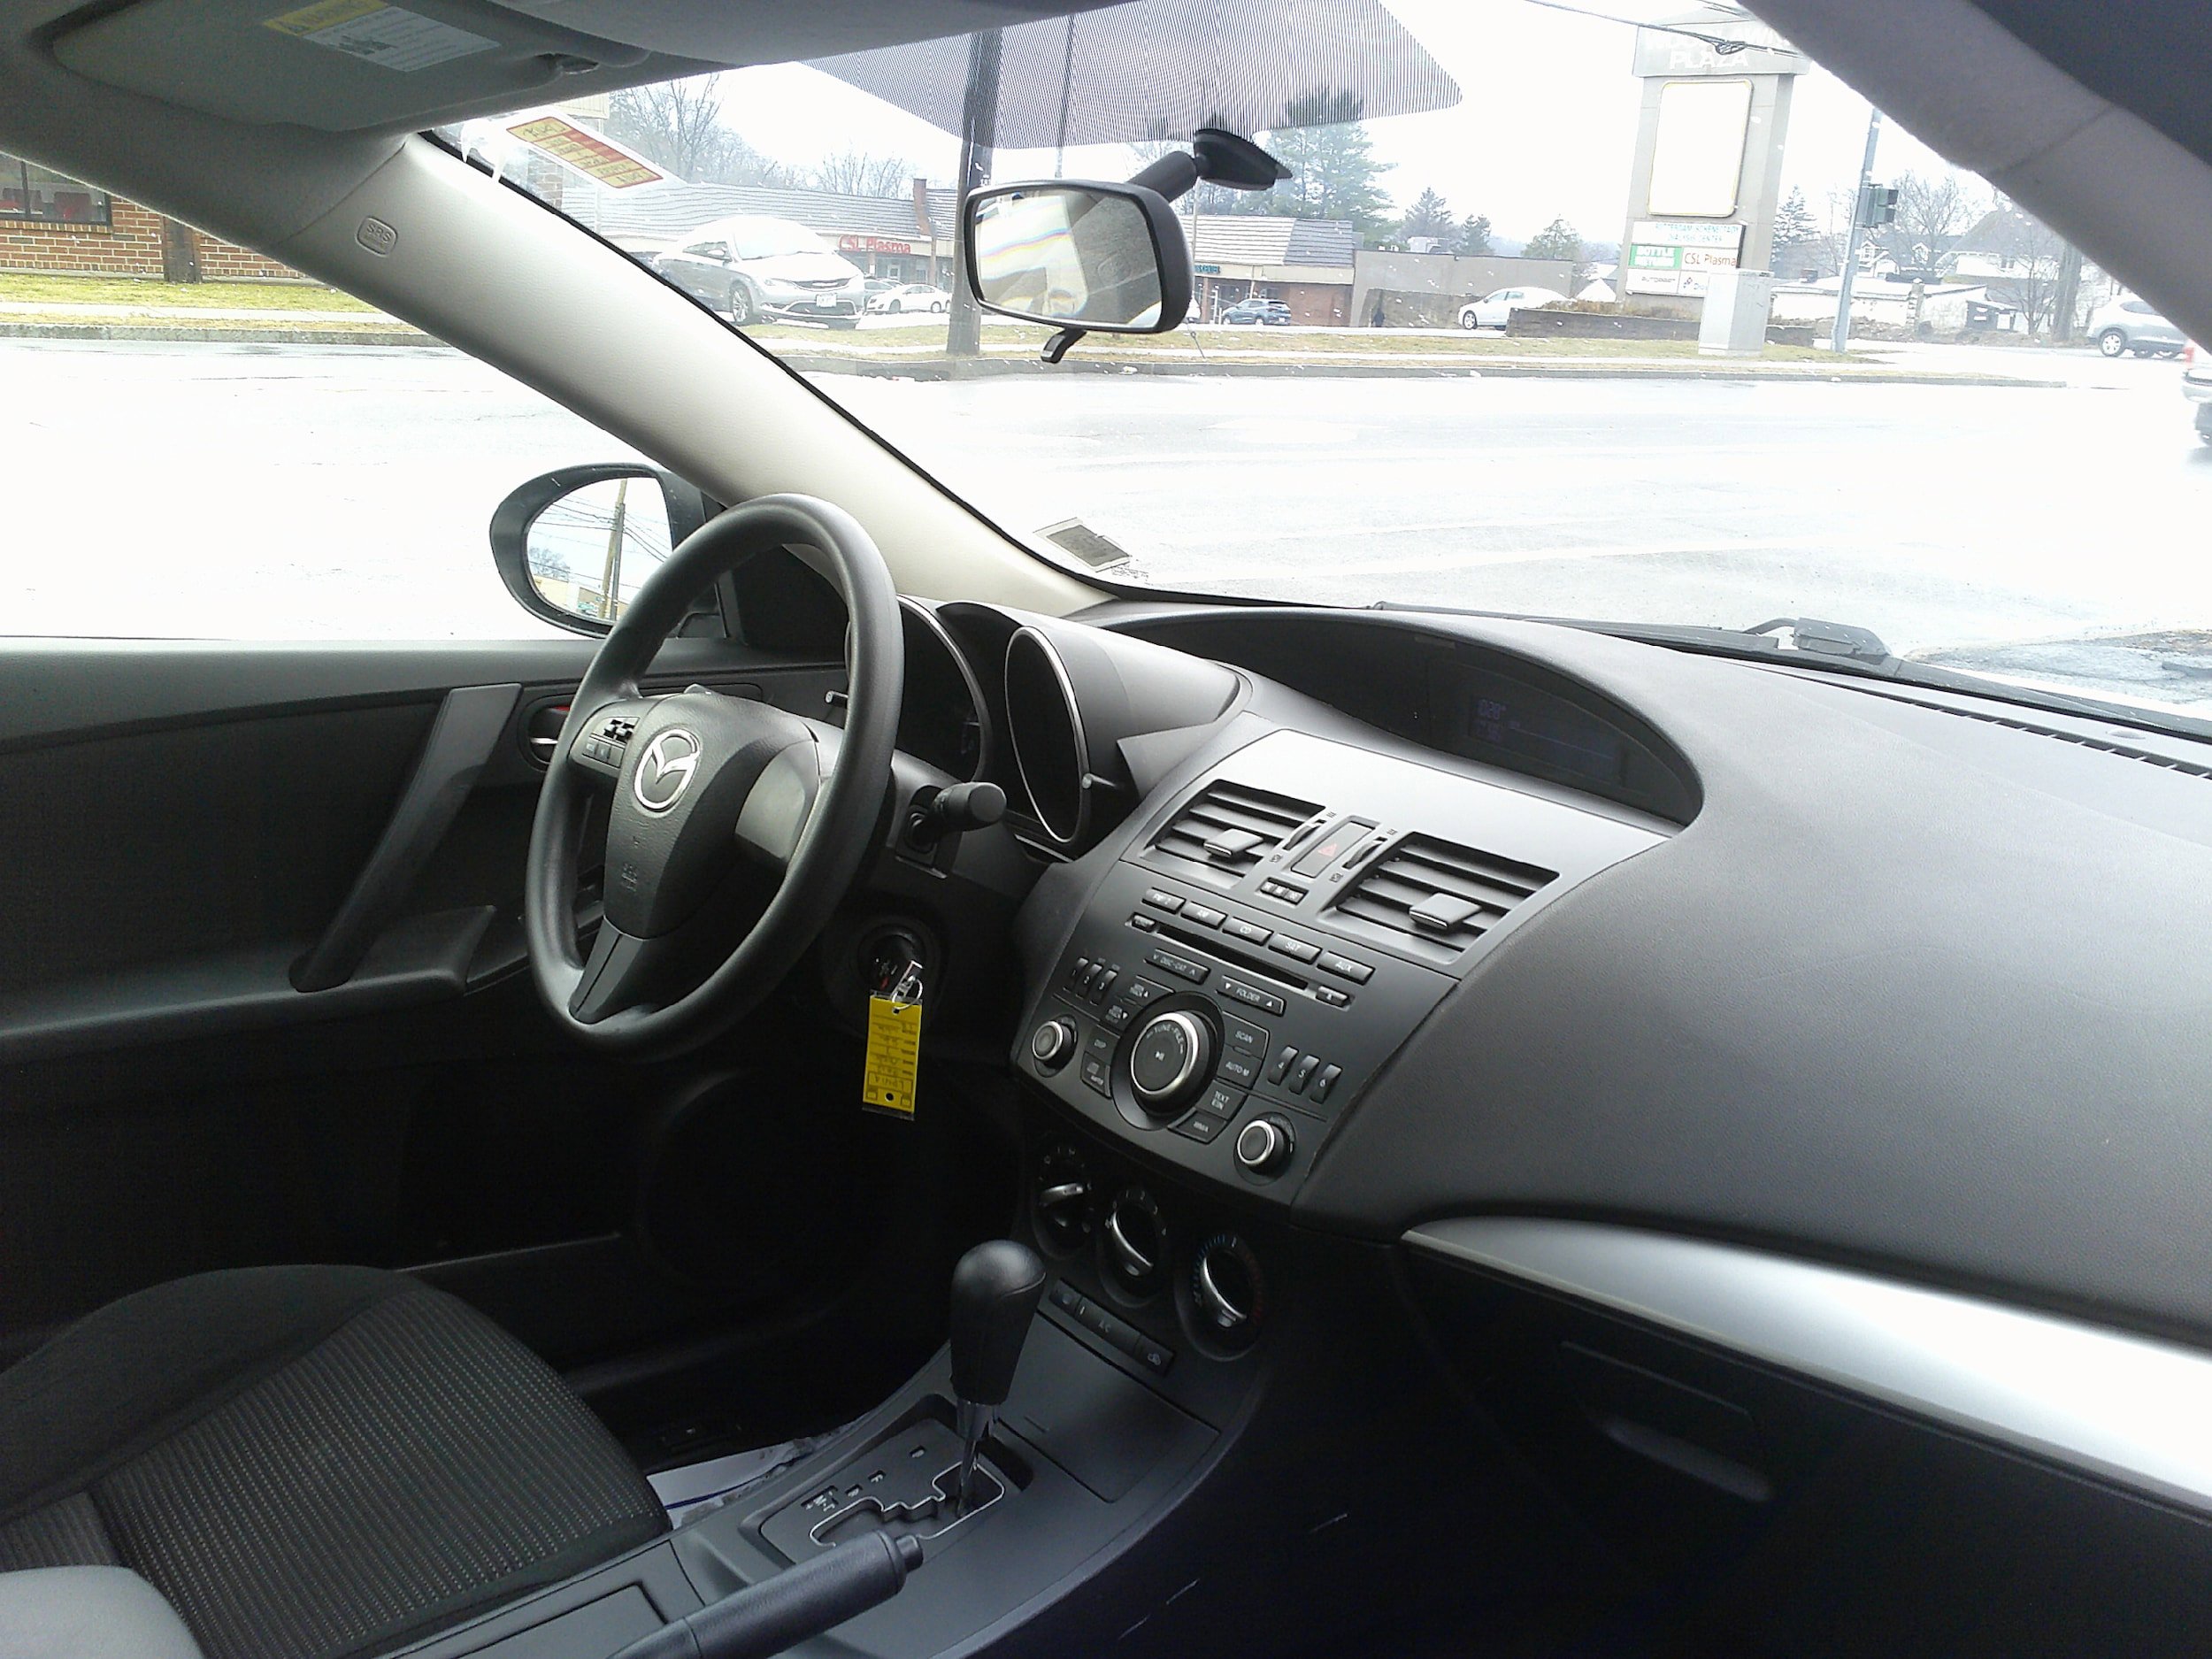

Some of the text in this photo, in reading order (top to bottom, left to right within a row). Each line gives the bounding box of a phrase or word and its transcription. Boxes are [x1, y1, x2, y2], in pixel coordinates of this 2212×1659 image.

[1670, 48, 1749, 70] PLAZA
[367, 223, 392, 242] SRS
[866, 235, 911, 254] Plasma
[1684, 252, 1737, 266] CSL Plasma
[1284, 941, 1301, 953] SAT
[1335, 960, 1352, 972] AUX
[1236, 987, 1260, 1002] FOLDER
[1235, 1030, 1253, 1044] SCAN
[1214, 1090, 1231, 1102] TEXT
